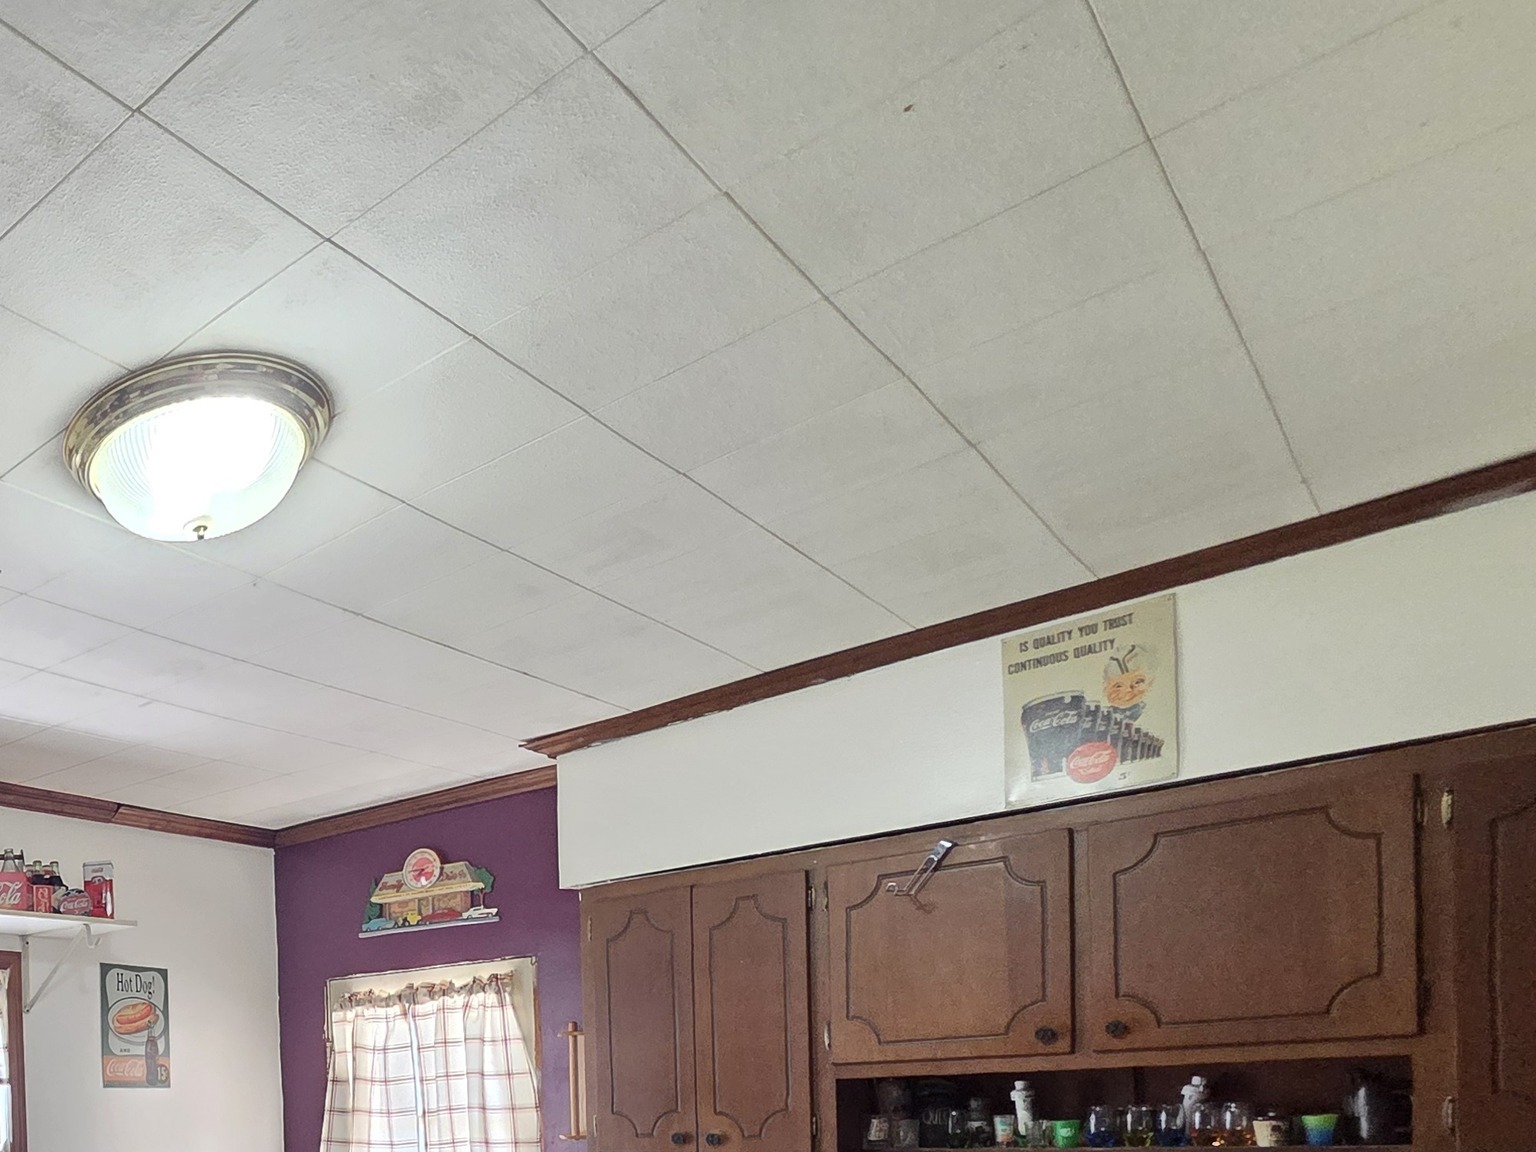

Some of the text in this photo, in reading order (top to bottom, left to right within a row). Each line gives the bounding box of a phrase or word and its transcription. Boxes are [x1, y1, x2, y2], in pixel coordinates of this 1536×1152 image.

[1019, 613, 1134, 653] IS QUALITY YOU TRUST
[1008, 650, 1069, 675] CONTINUOUS
[116, 972, 155, 1000] Hot Dog!
